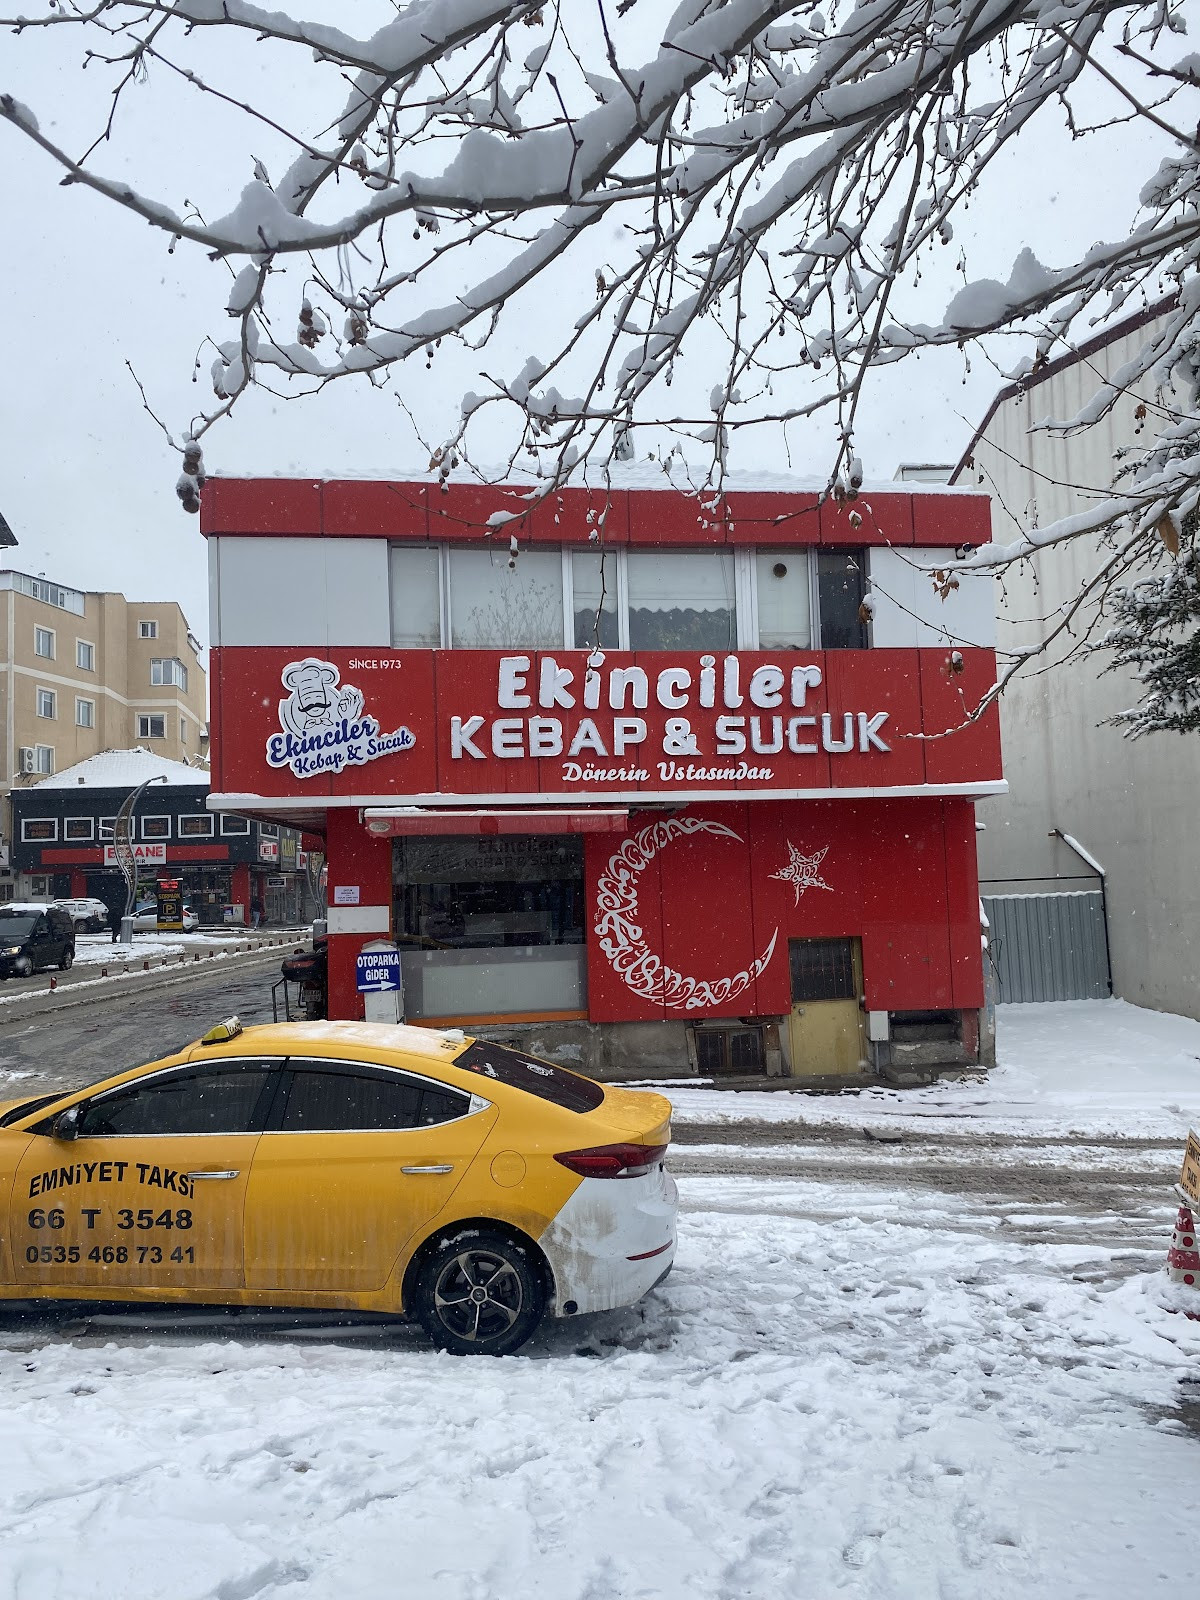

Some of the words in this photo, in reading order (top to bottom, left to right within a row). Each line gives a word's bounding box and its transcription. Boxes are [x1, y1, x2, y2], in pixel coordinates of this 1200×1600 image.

[379, 659, 402, 670] 1973
[497, 652, 823, 710] Ekinciler
[269, 719, 377, 764] Ekinciler
[450, 715, 648, 760] KEBAP
[662, 717, 703, 757] &
[715, 711, 892, 756] SUCUK
[294, 750, 346, 775] Kebap
[347, 746, 364, 762] &
[367, 729, 413, 757] Sucuk
[561, 761, 650, 782] Dönerin
[658, 760, 775, 782] Ustasından
[356, 954, 400, 968] OTOPARKA
[27, 1208, 65, 1230] 66
[81, 1208, 102, 1230] T
[116, 1208, 193, 1230] 3548
[25, 1246, 81, 1264] 0535
[88, 1246, 129, 1264] 468
[136, 1246, 163, 1264] 73
[170, 1246, 196, 1264] 41
